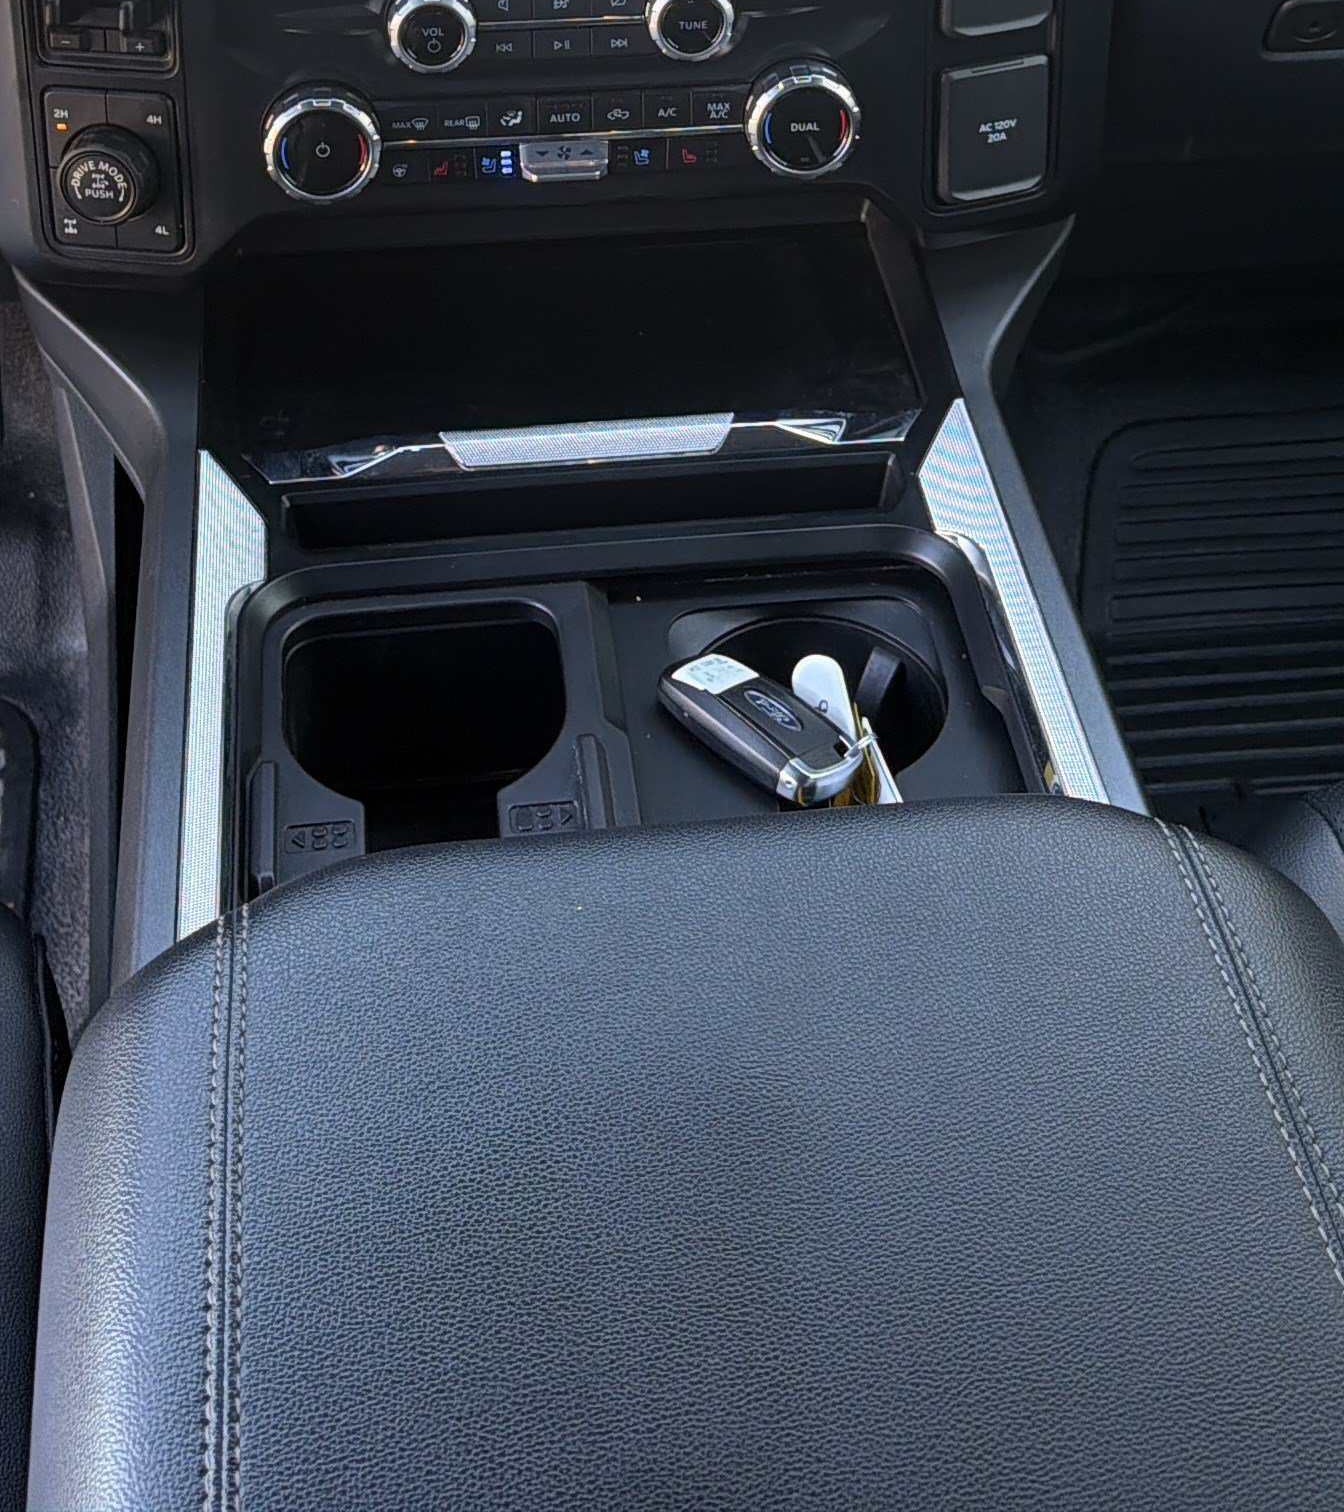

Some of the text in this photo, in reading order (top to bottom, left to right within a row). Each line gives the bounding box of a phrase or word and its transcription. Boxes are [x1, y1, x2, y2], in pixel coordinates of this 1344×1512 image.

[678, 20, 708, 30] TUNE
[422, 27, 444, 37] VOL
[707, 102, 731, 111] MAX
[53, 109, 69, 119] 2H
[658, 107, 677, 117] A/C
[709, 110, 729, 119] A/C
[146, 114, 162, 125] 4H
[444, 118, 465, 126] REAR
[549, 113, 581, 123] AUTO
[392, 121, 412, 129] MAX
[790, 122, 821, 132] DUAL
[979, 118, 1018, 133] AC 120V
[987, 131, 1008, 143] 20A
[71, 160, 128, 189] DRIVE MODE
[84, 189, 114, 200] PUSH
[155, 225, 170, 236] 4L
